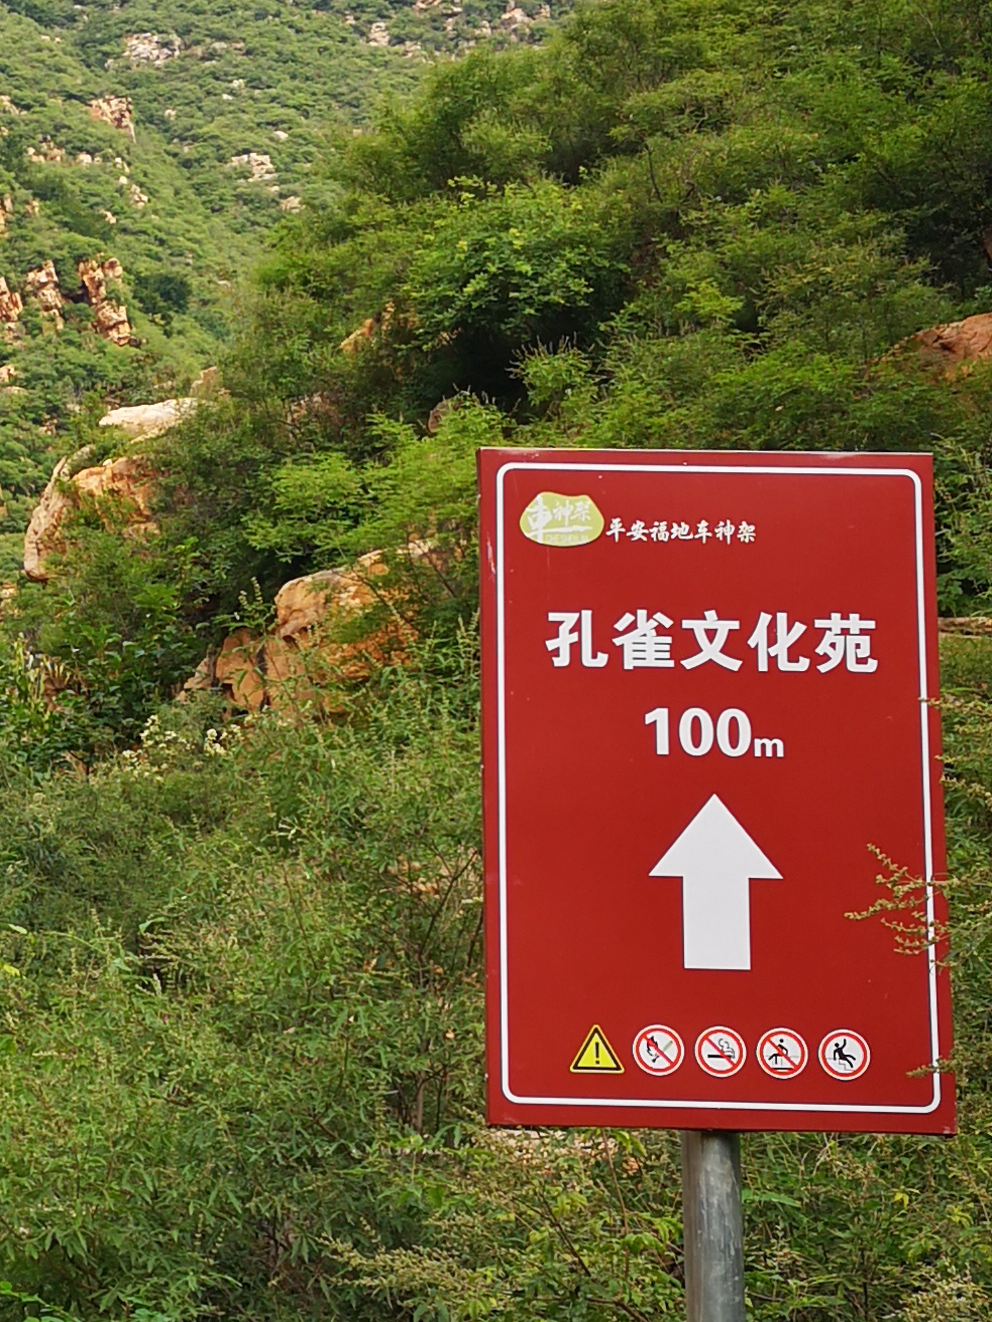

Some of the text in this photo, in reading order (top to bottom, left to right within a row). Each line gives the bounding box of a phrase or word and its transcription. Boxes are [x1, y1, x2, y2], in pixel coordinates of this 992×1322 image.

[605, 517, 756, 545] 平安福地车神架
[545, 609, 879, 674] 孔雀文化苑
[644, 707, 785, 758] 100m
